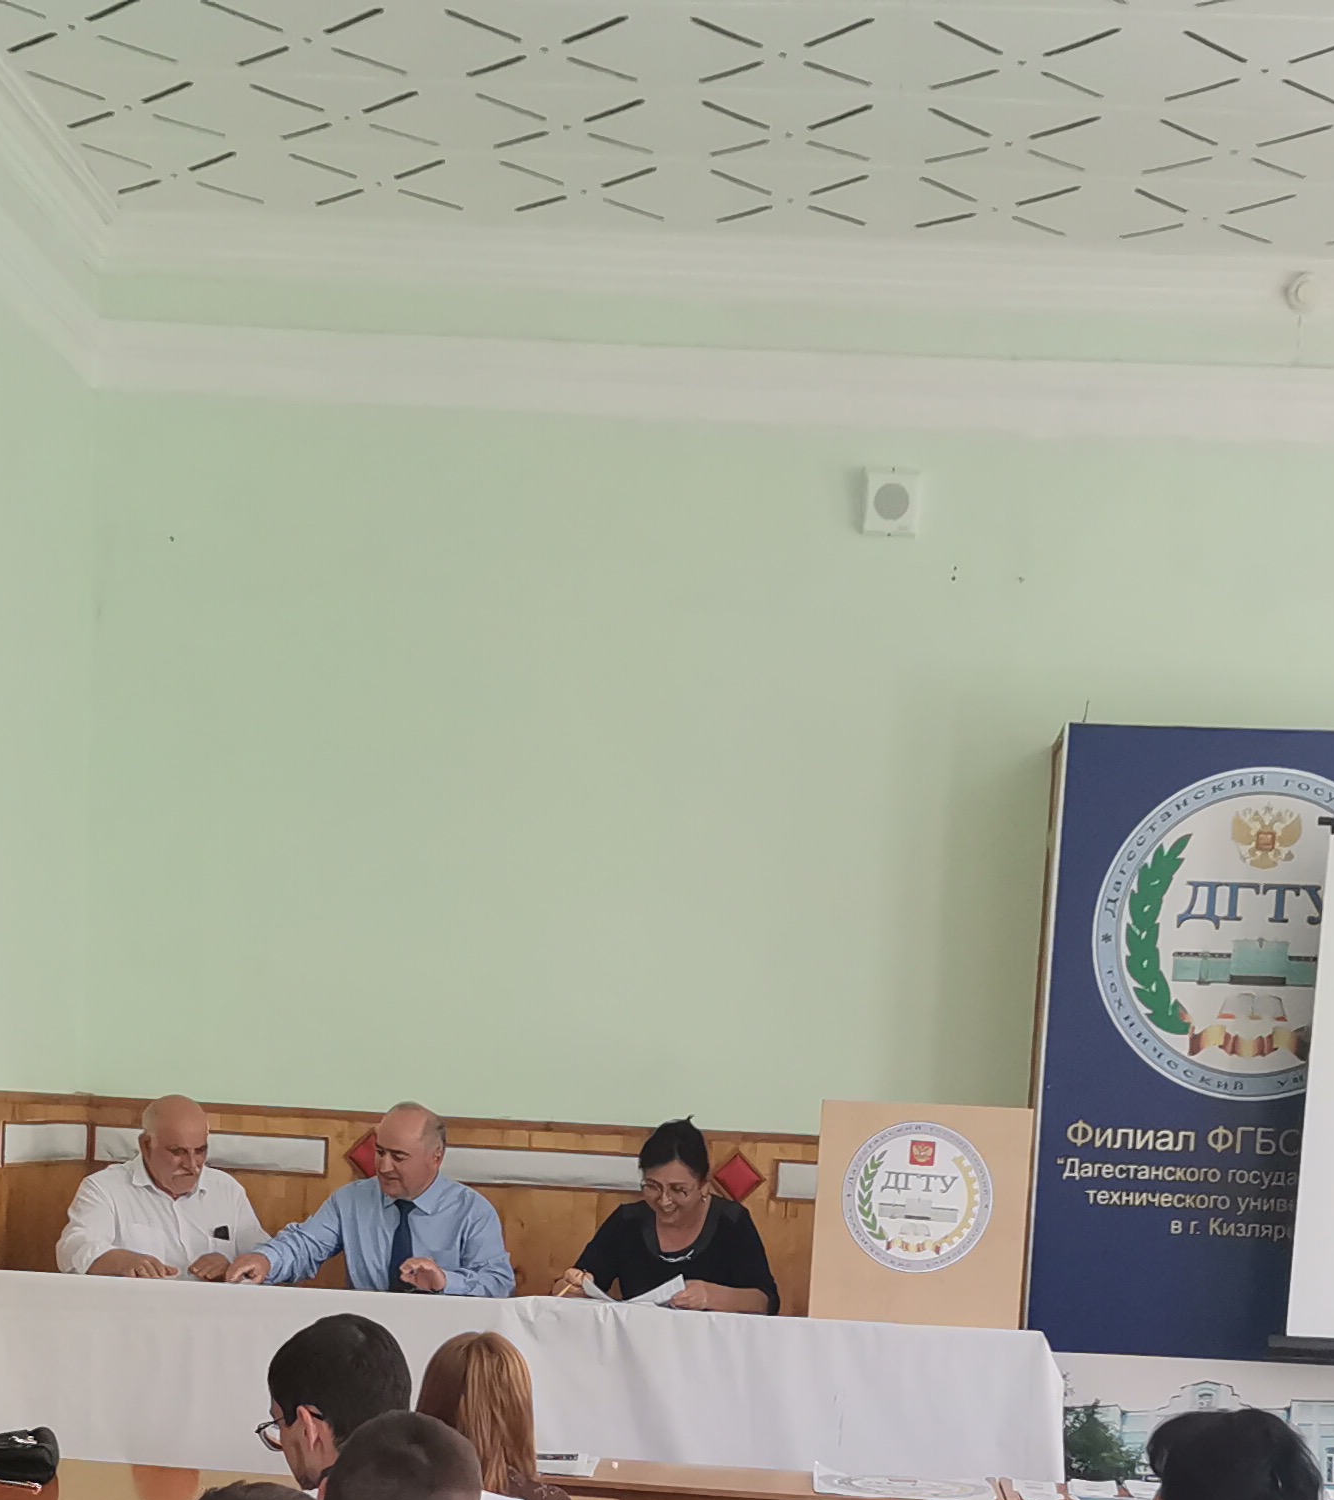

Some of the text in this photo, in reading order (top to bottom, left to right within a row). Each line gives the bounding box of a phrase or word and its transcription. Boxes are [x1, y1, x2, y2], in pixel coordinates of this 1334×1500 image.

[1066, 1119, 1196, 1153] Филиал
[879, 1169, 960, 1195] ДГТУ
[1084, 1189, 1231, 1211] технического
[1169, 1219, 1183, 1235] в
[1189, 1220, 1201, 1236] г.
